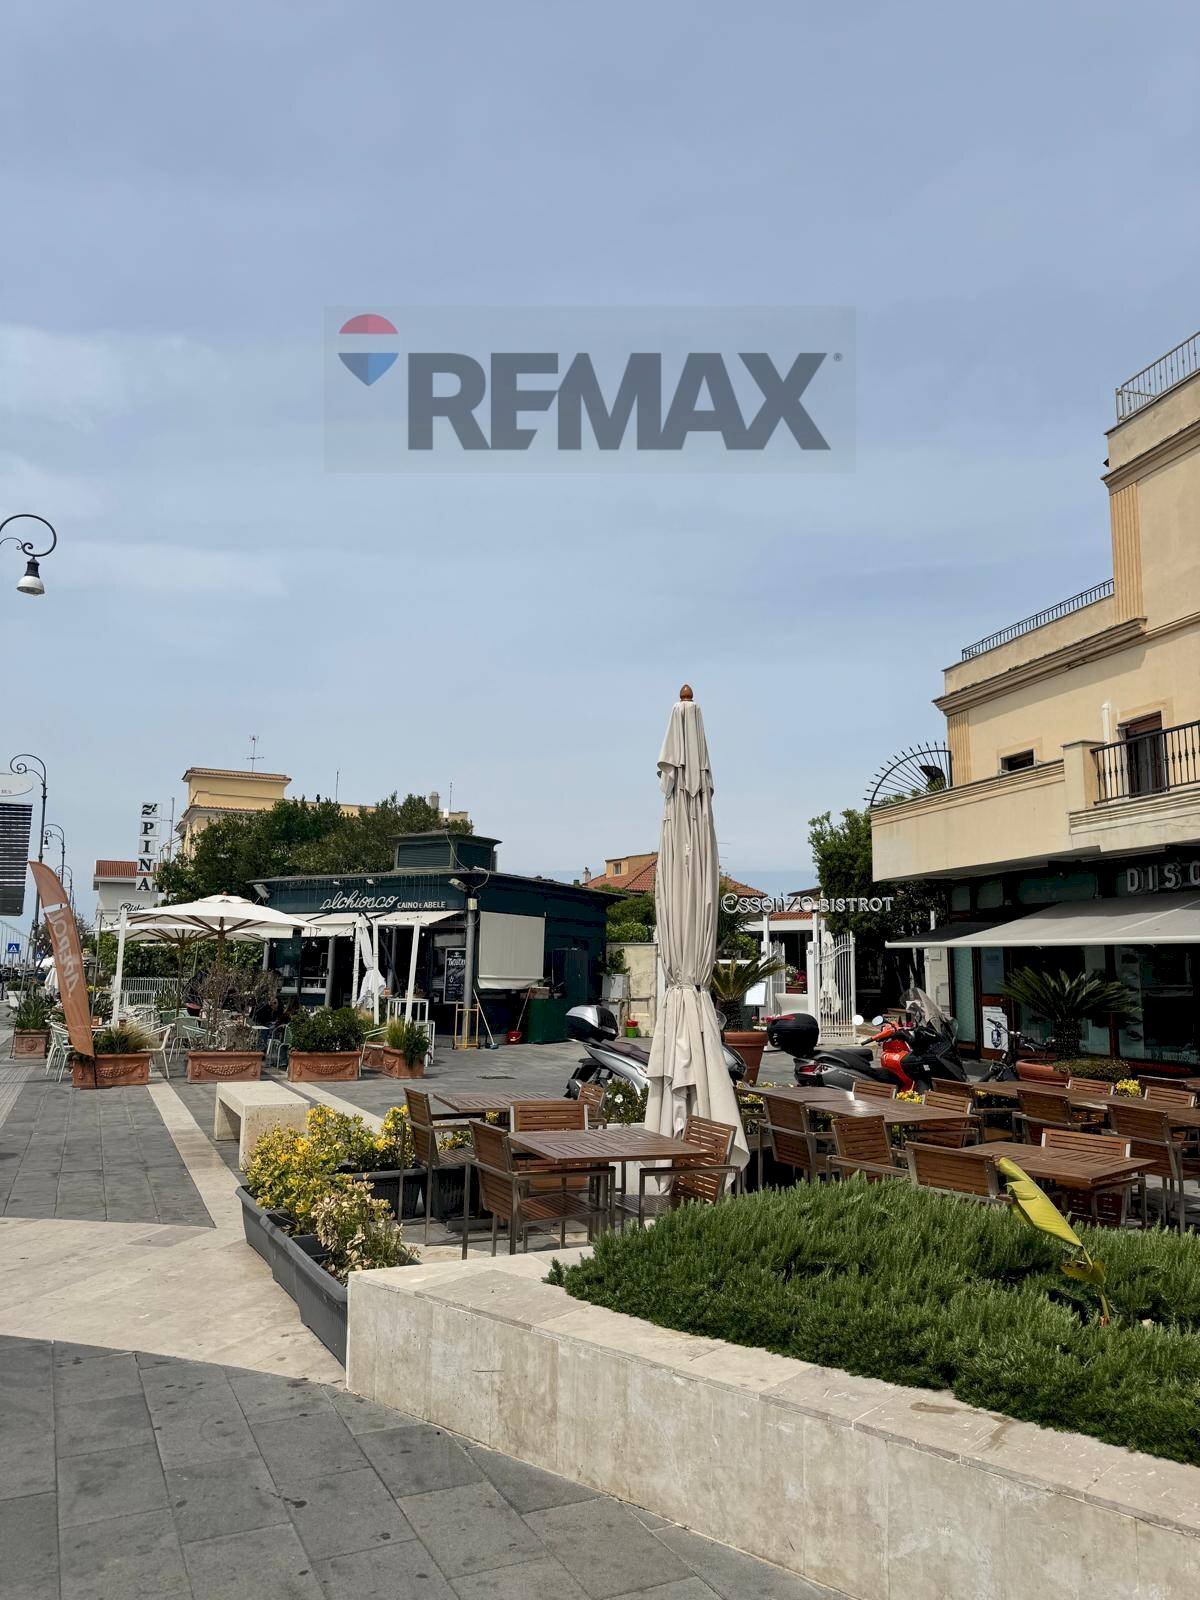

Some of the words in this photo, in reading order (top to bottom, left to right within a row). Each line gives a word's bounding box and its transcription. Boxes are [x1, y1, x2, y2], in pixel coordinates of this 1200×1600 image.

[137, 821, 155, 891] PINA
[319, 890, 399, 910] alchiosco
[424, 901, 446, 909] ABELE
[818, 896, 894, 912] BISTROT
